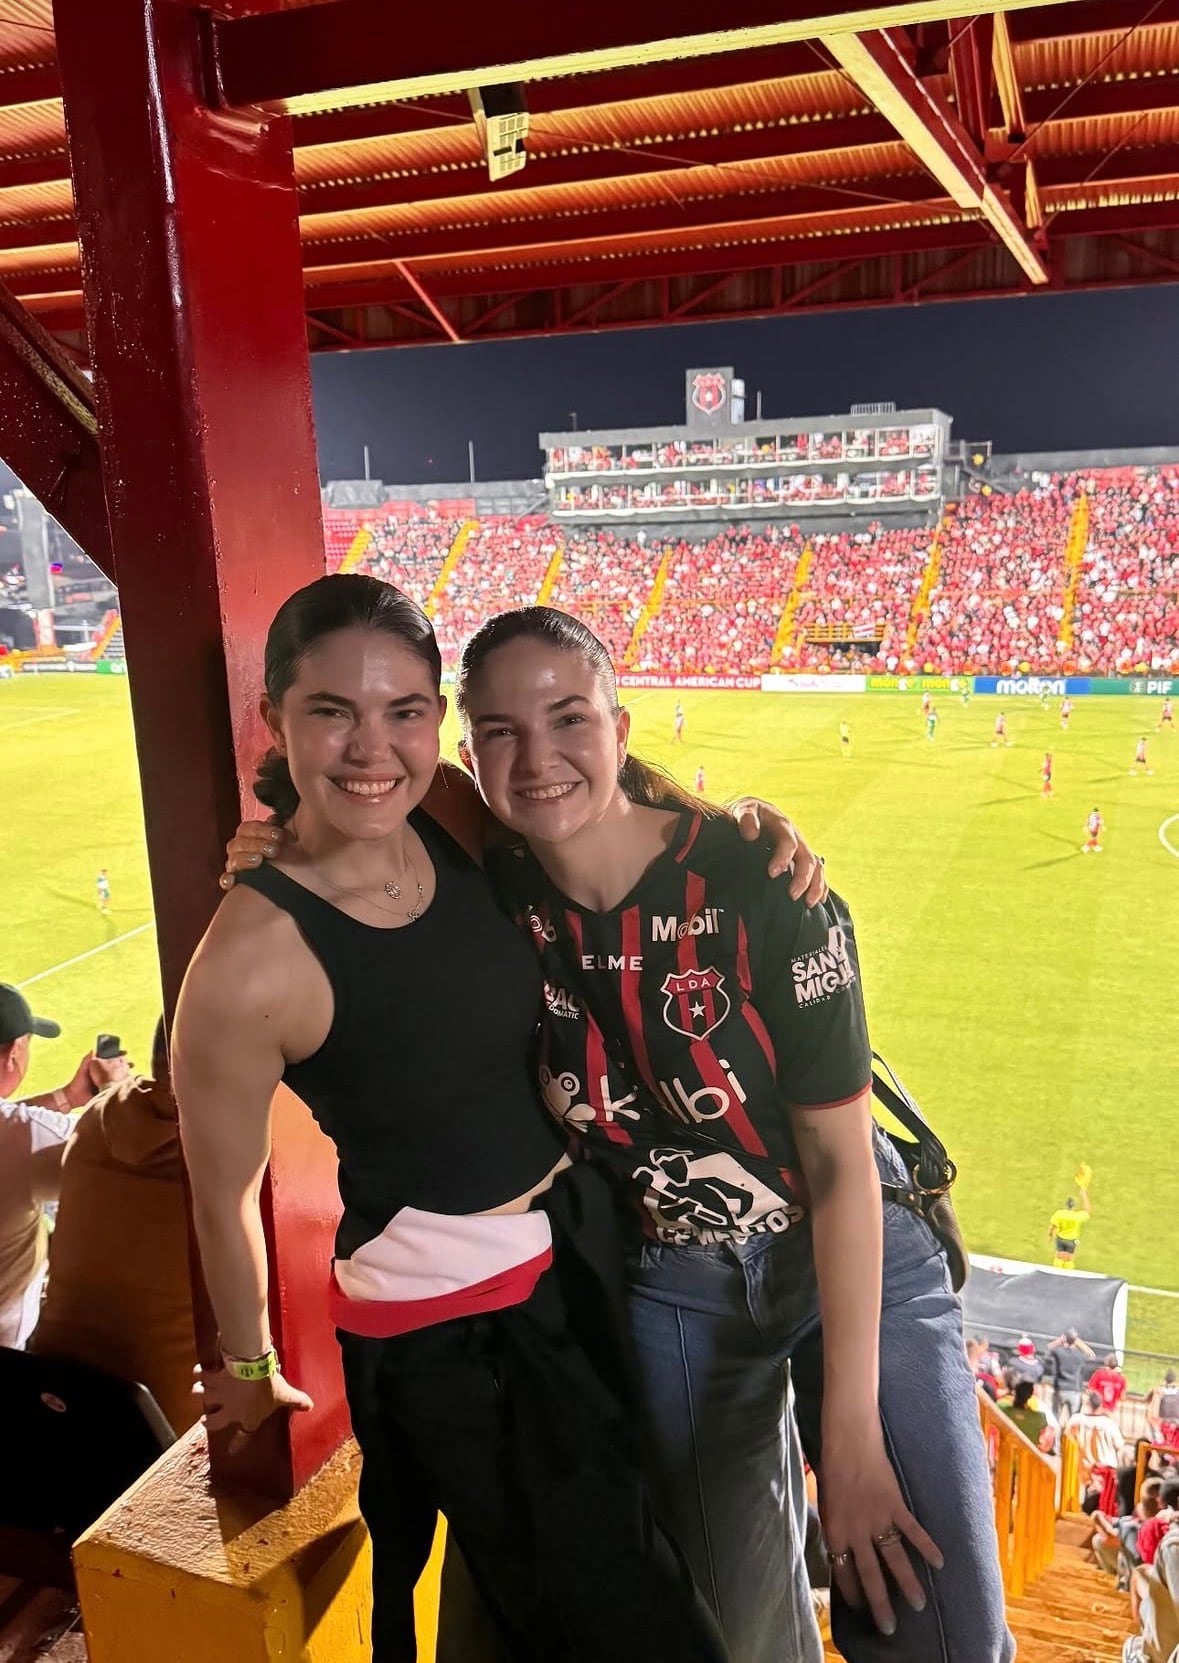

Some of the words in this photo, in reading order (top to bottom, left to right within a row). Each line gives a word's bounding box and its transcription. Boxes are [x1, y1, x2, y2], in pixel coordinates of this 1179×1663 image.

[621, 676, 671, 687] CENTRAL
[674, 676, 734, 687] AMERICAN
[735, 677, 761, 688] CUP
[1147, 681, 1173, 694] PIF
[791, 951, 838, 983] SAN
[676, 977, 711, 992] LDA
